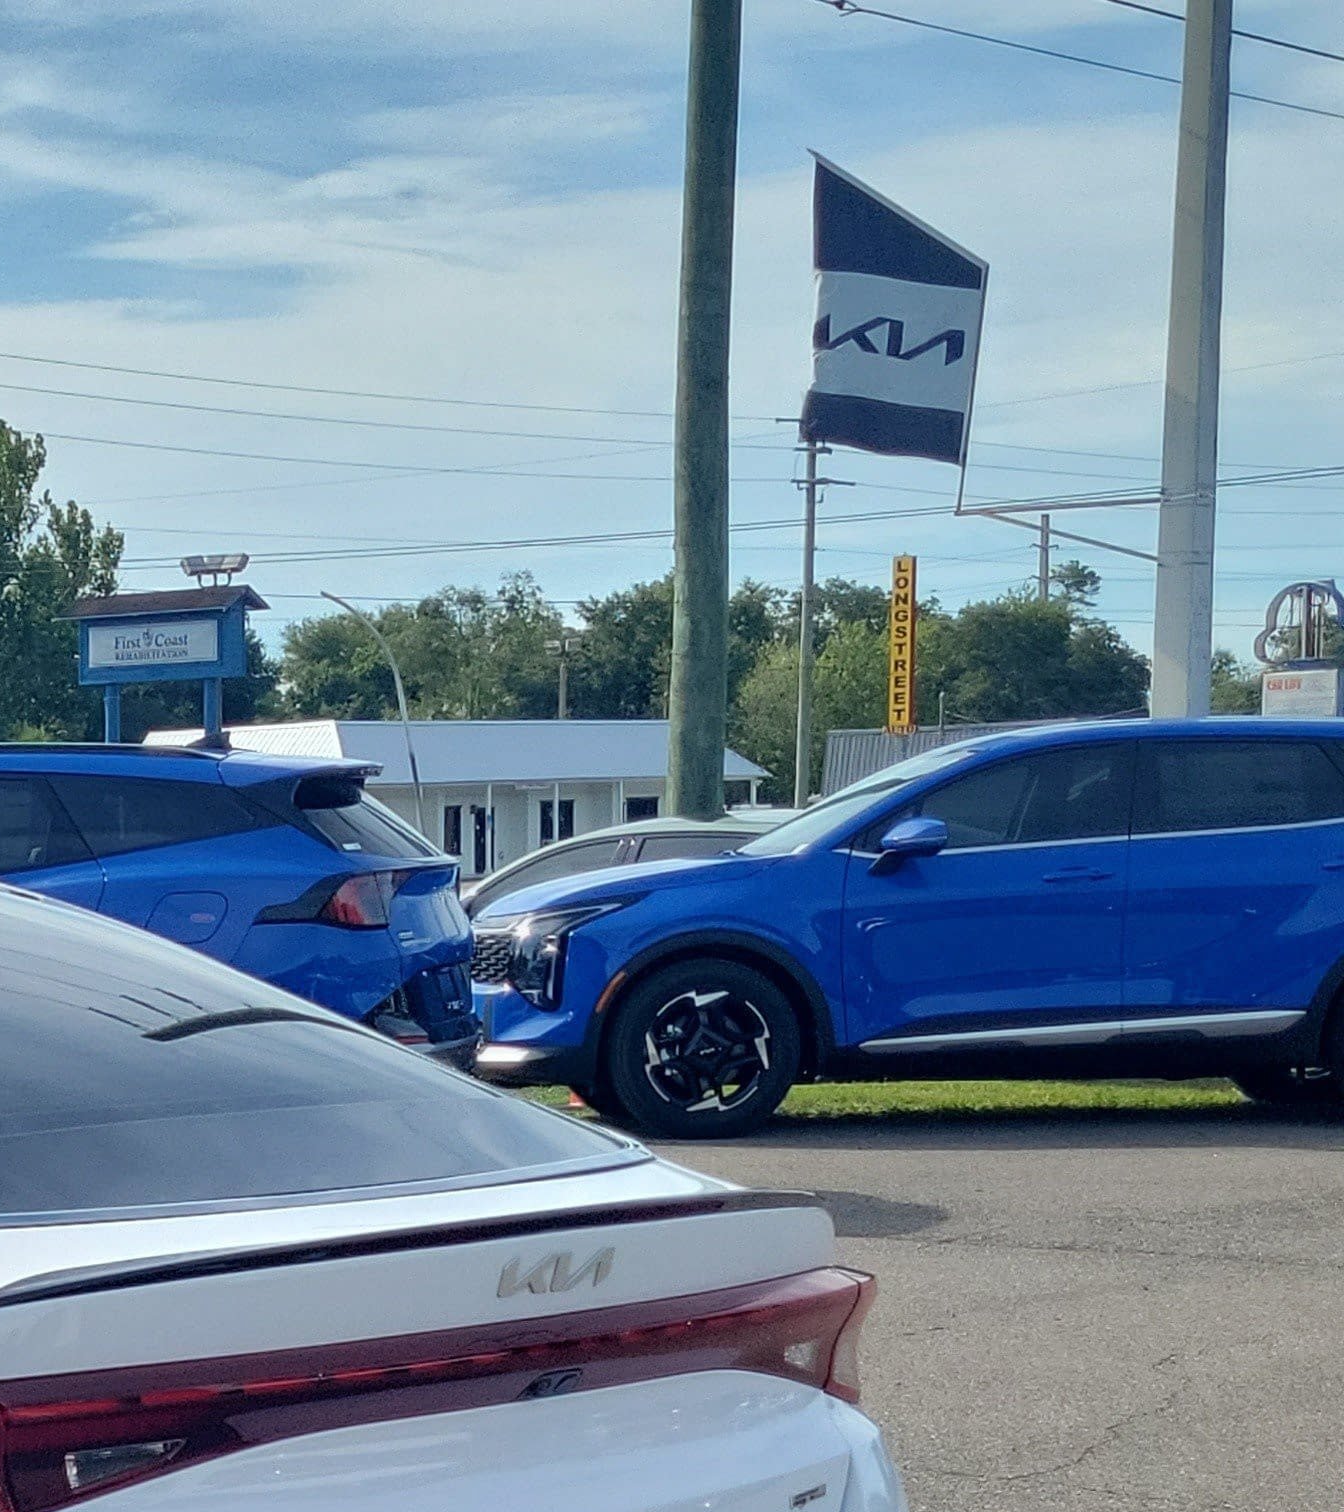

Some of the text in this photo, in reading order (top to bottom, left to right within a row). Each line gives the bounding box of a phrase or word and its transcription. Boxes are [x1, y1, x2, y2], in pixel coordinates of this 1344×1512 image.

[813, 313, 965, 366] KIA
[114, 633, 188, 650] First Coast
[893, 560, 909, 721] LONGSTREET
[497, 1246, 616, 1298] KIA
